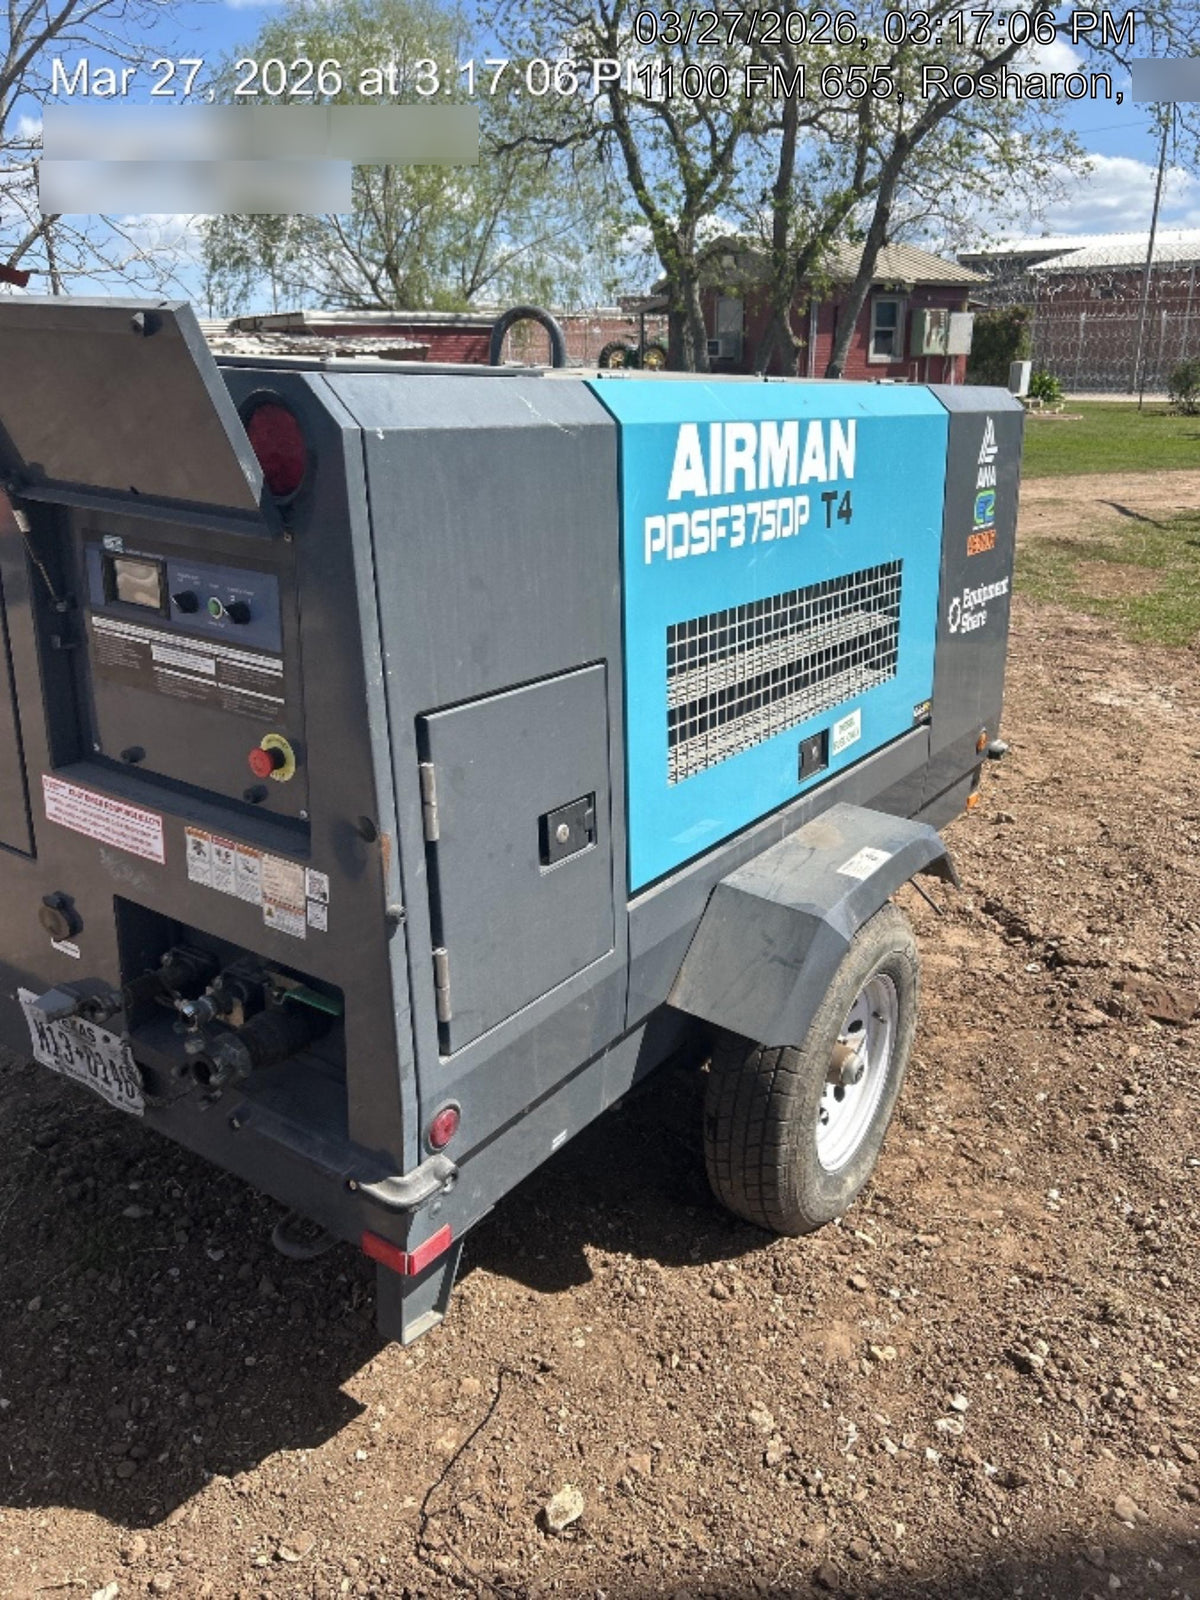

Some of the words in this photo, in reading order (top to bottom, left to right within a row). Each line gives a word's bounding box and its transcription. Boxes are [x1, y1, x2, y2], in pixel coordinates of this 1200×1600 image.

[667, 418, 857, 501] AIRMAN
[644, 494, 811, 565] PDSF375DP
[821, 490, 853, 529] T4
